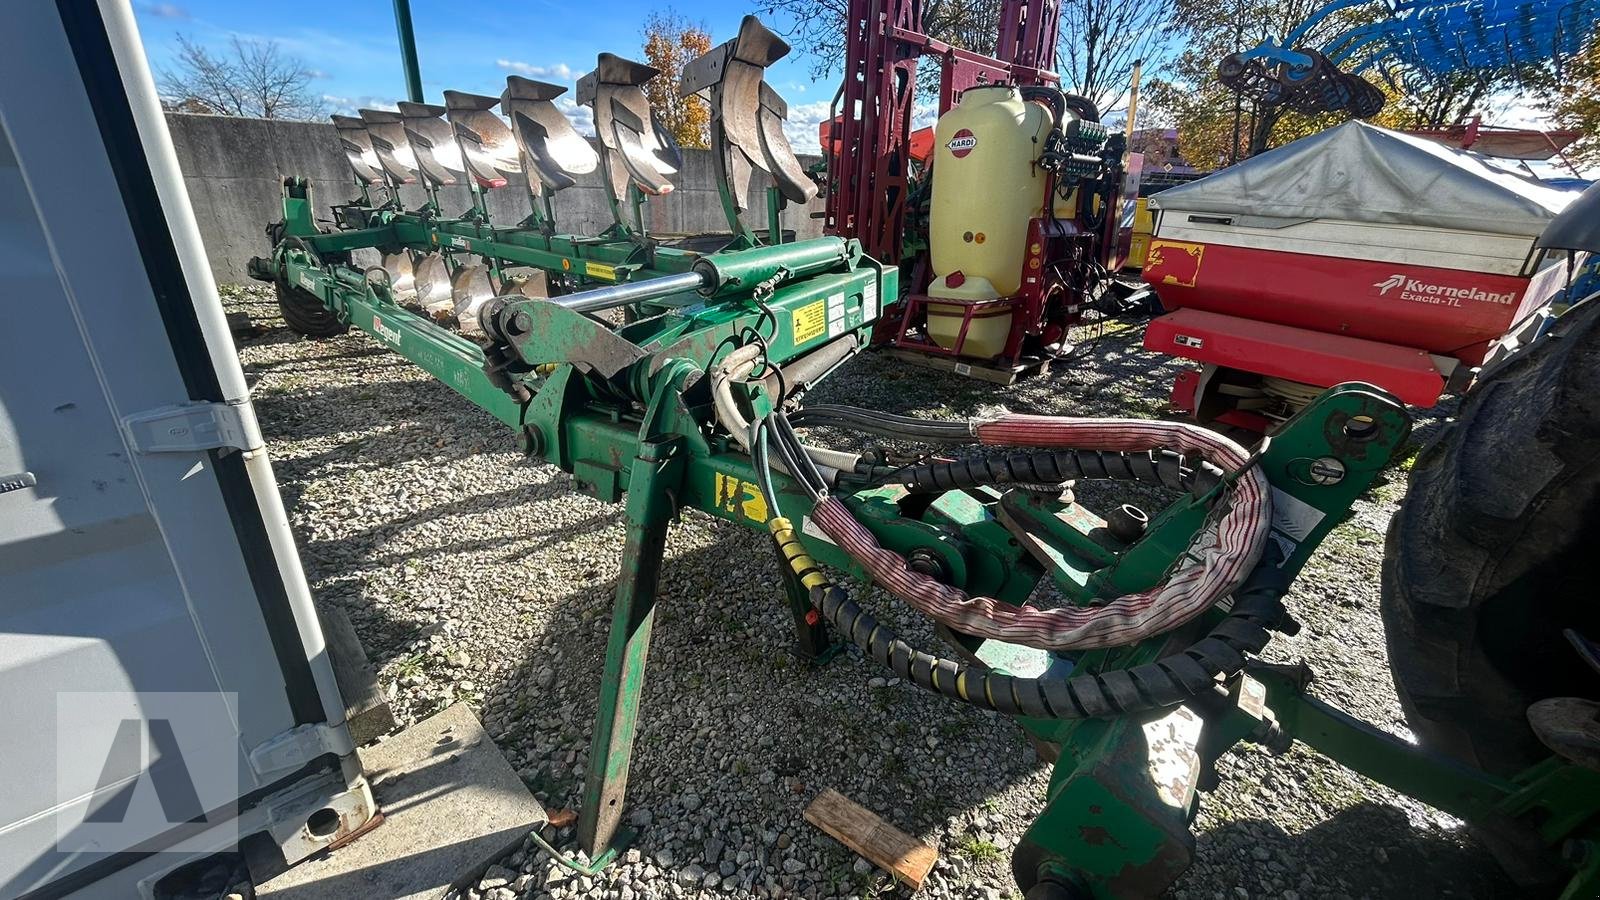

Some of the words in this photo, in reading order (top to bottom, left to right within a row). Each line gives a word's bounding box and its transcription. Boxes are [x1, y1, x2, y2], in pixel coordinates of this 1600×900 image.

[952, 139, 973, 147] HARDI
[1405, 279, 1515, 304] Kverneland
[373, 315, 402, 346] Regent
